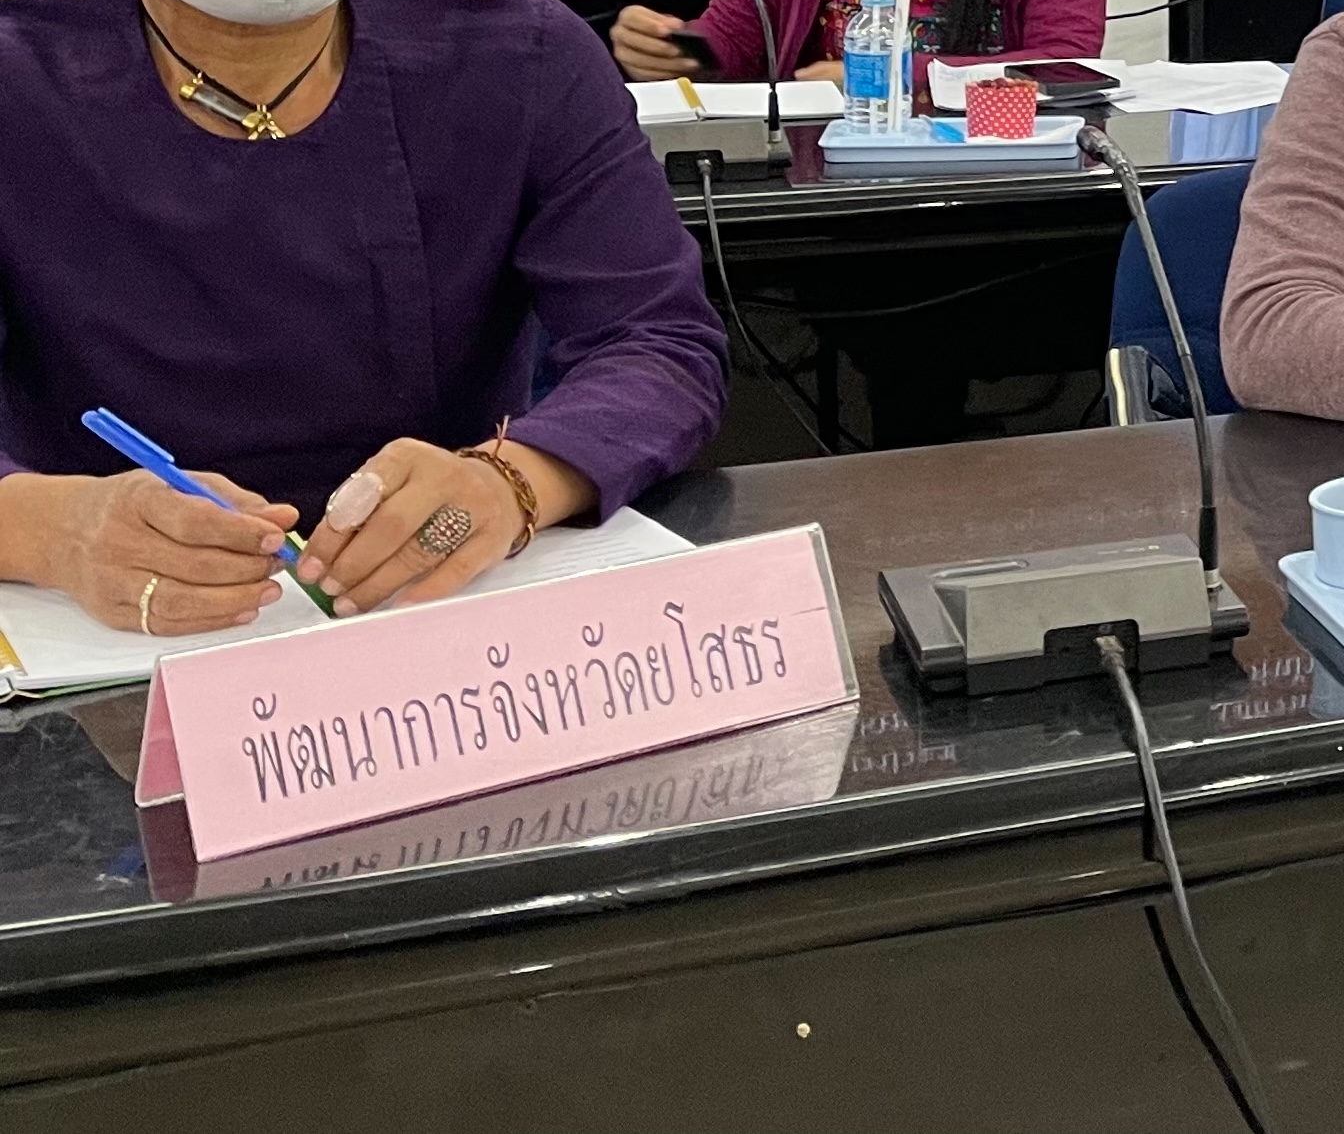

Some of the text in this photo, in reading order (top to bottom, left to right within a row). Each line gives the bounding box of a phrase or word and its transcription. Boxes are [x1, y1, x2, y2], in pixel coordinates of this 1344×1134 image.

[241, 601, 788, 804] พัฒนาการจังหวัดยโสธร
